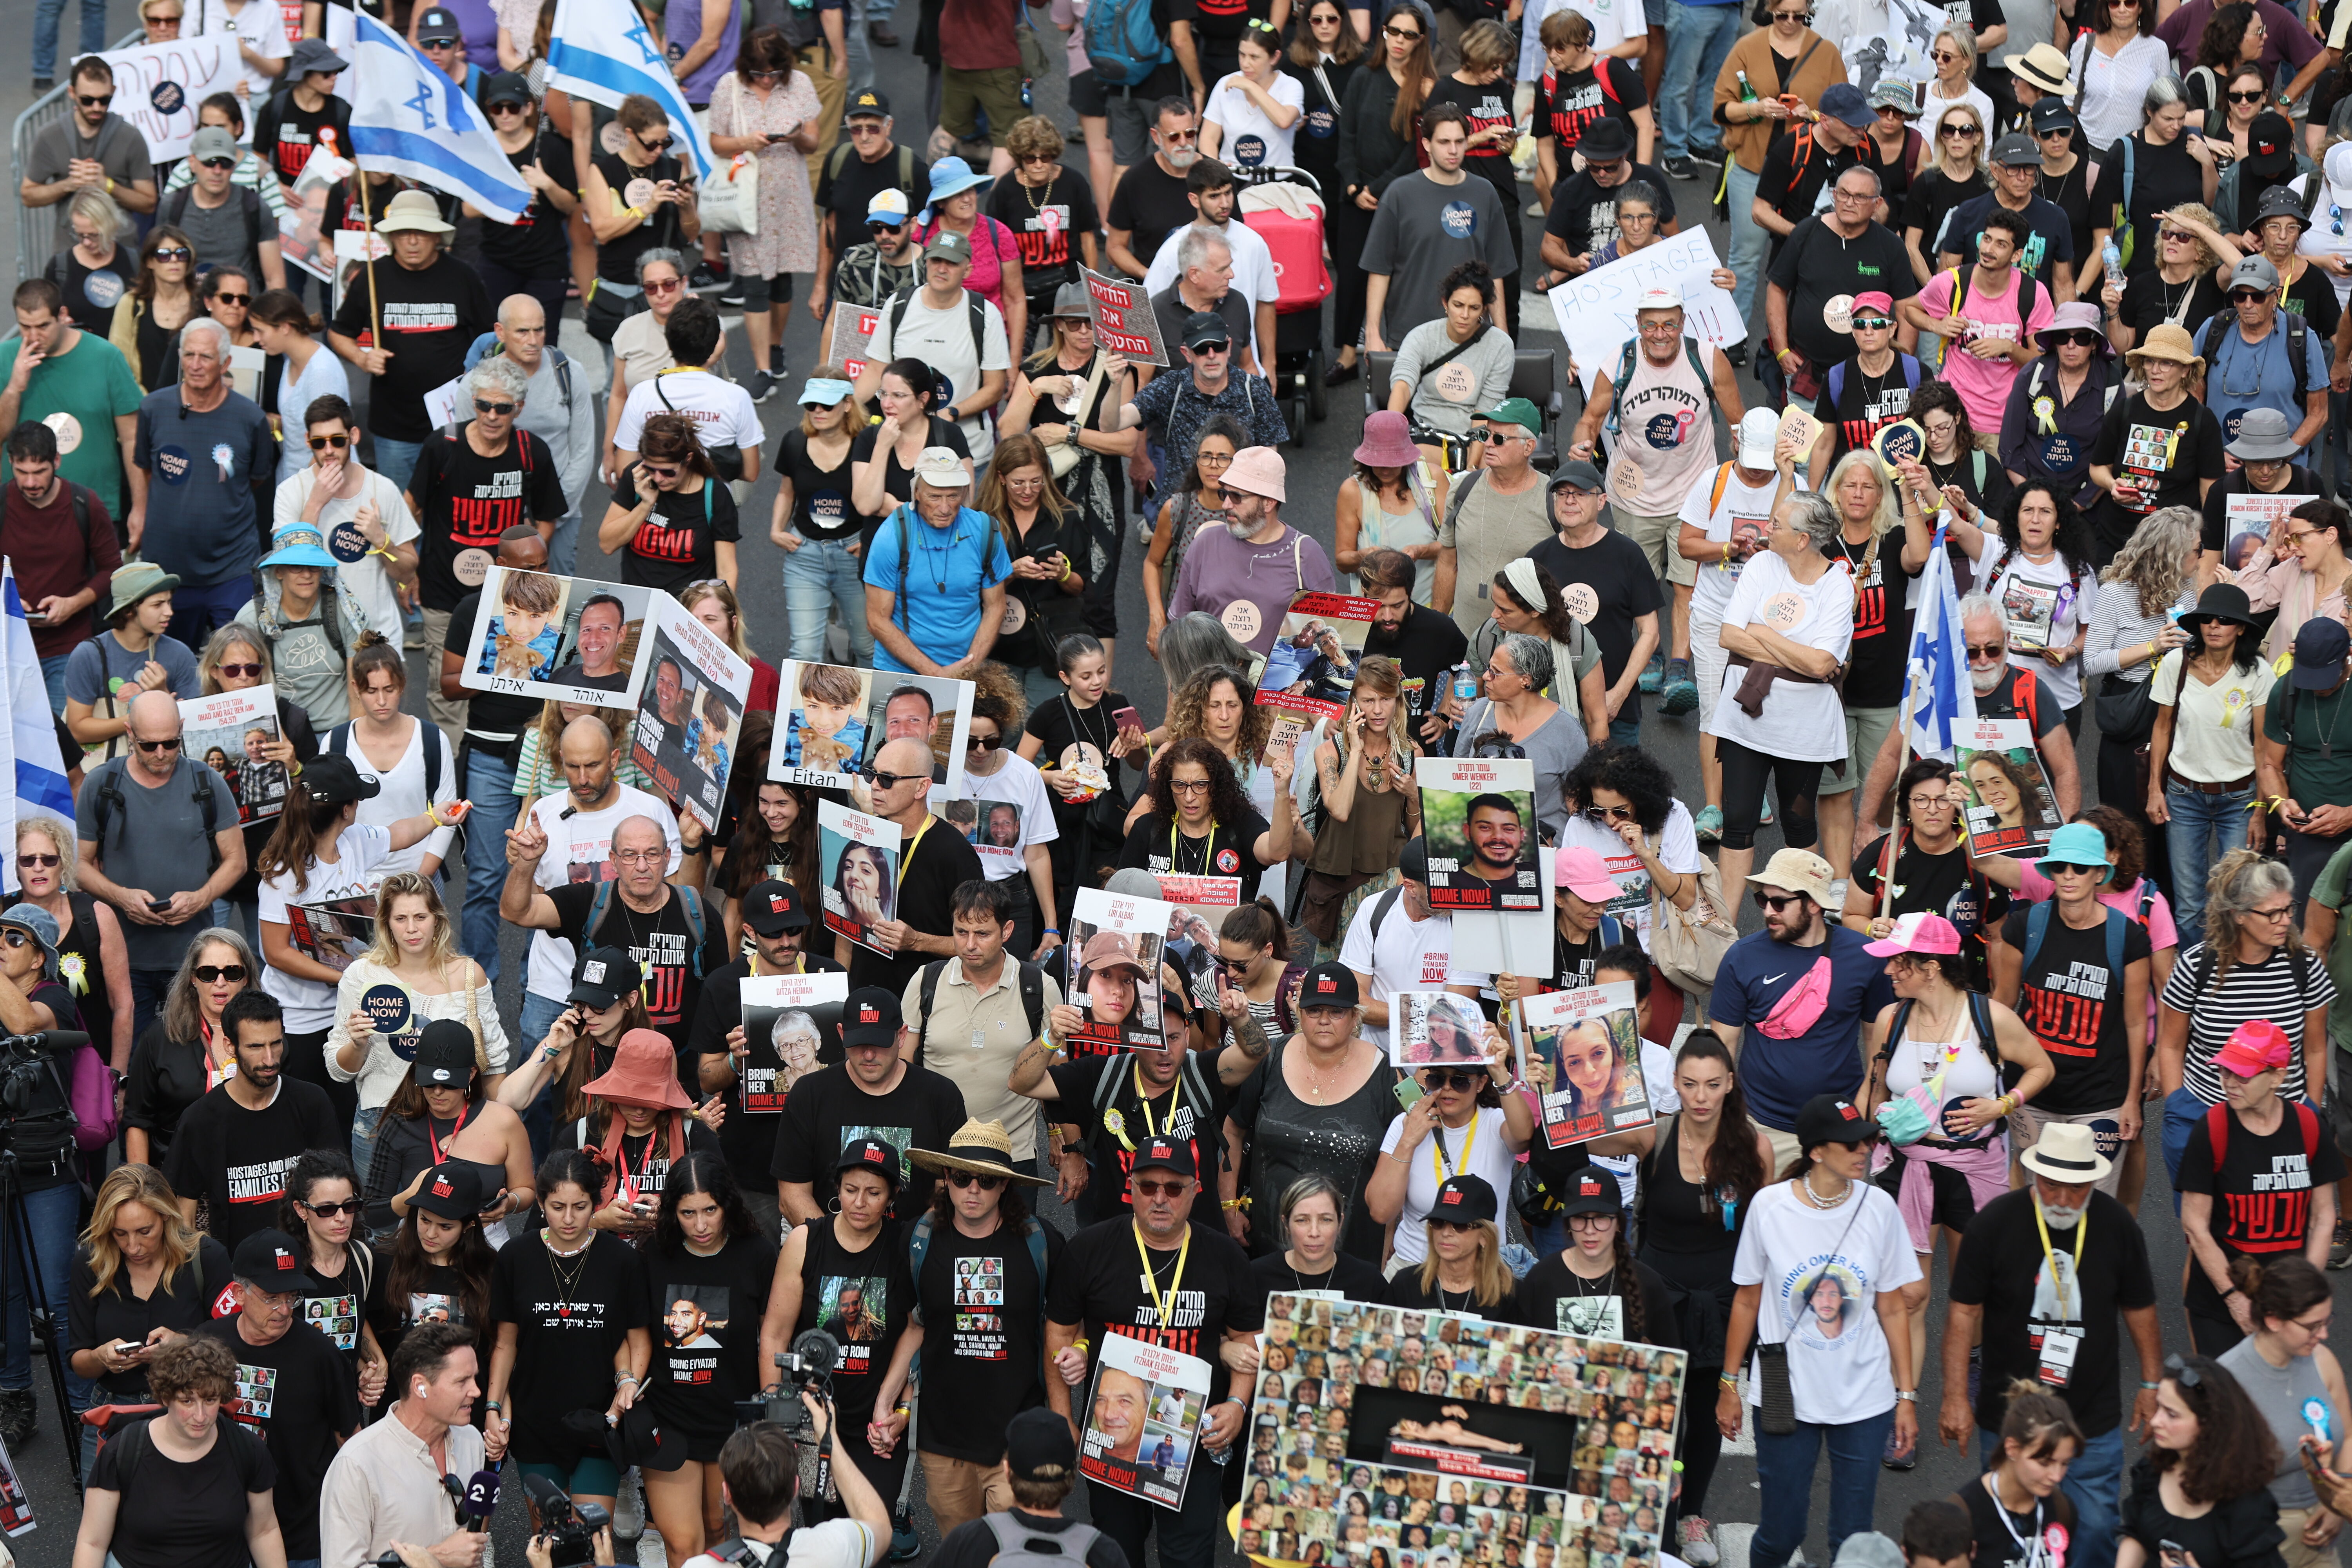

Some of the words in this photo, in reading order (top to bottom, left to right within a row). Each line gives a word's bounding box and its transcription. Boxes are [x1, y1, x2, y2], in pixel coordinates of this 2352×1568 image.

[1310, 118, 1332, 128] NOW
[1446, 210, 1472, 220] HOME
[1449, 218, 1471, 227] NOW
[1089, 279, 1128, 306] החזירו
[1101, 307, 1120, 326] את
[1096, 324, 1149, 352] החטופים
[1442, 383, 1466, 392] הביתה
[1624, 387, 1700, 416] דמוקרטיה
[1795, 418, 1806, 427] אני
[1788, 424, 1805, 436] רוצה
[1782, 429, 1804, 446] הביתה
[1885, 431, 1913, 451] HOME
[160, 452, 189, 468] HOME
[2046, 453, 2072, 462] הביתה
[161, 461, 184, 475] NOW
[1624, 465, 1633, 473] אני
[474, 485, 501, 499] הביתה
[817, 507, 841, 515] NOW
[651, 512, 670, 528] HOME
[336, 529, 366, 546] HOME
[335, 538, 363, 553] NOW
[1577, 590, 1587, 599] אני
[2018, 584, 2047, 598] KIDNAPPED
[1569, 596, 1588, 607] רוצה
[1777, 602, 1794, 615] רוצה
[1787, 598, 1797, 607] אני
[1338, 612, 1371, 620] KIDNAPPED
[675, 622, 687, 639] OHAD
[688, 633, 697, 648] AND
[698, 642, 710, 660] EITAN
[710, 653, 734, 681] YAHALOMI
[490, 677, 524, 691] איתן
[573, 688, 604, 703] אוהד
[198, 713, 212, 721] OHAD
[218, 716, 237, 726] (54,57)
[639, 707, 665, 741] BRING
[637, 724, 659, 756] THEM
[632, 742, 656, 772] HOME
[655, 762, 680, 796] NOW!
[793, 768, 837, 787] Eitan
[1469, 782, 1481, 791] (22)
[1966, 805, 1996, 822] BRING
[1971, 819, 1993, 834] HER
[1973, 831, 1998, 848] HOME
[2001, 826, 2026, 842] NOW!
[1428, 858, 1458, 872] BRING
[1429, 873, 1449, 886] HIM
[823, 884, 841, 903] BRING
[1430, 889, 1459, 902] HOME
[1461, 887, 1490, 903] NOW!
[771, 898, 790, 911] NOW
[304, 909, 318, 924] HIM
[317, 912, 333, 933] BRING
[1114, 919, 1123, 929] (18)
[650, 933, 686, 949] מחזירים
[2070, 961, 2109, 984] מחזירים
[1318, 981, 1337, 991] NOW
[2045, 973, 2080, 993] הביתה
[2078, 978, 2107, 1000] אותם
[793, 987, 813, 995] HEIMAN
[368, 997, 403, 1007] HOME
[790, 996, 800, 1004] (84)
[1069, 992, 1092, 1008] BRING
[1553, 1005, 1573, 1014] MORAN
[1574, 1000, 1590, 1009] STELA
[1592, 996, 1608, 1005] YANAI
[370, 1008, 401, 1017] NOW
[860, 1011, 879, 1020] NOW
[1576, 1009, 1586, 1018] (40)
[748, 1068, 776, 1080] BRING
[748, 1081, 766, 1093] HER
[749, 1094, 774, 1105] HOME
[1544, 1091, 1572, 1109] BRING
[1546, 1106, 1565, 1124] HER
[1549, 1121, 1575, 1140] HOME
[1577, 1112, 1605, 1133] NOW!
[864, 1149, 885, 1161] NOW
[1152, 1147, 1172, 1157] NOW
[227, 1163, 267, 1180] HOSTAGES
[268, 1160, 284, 1174] AND
[229, 1174, 279, 1198] FAMILIES
[432, 1181, 454, 1196] NOW
[2253, 1173, 2286, 1191] הביתה
[277, 1255, 294, 1267] NOW
[532, 1302, 550, 1314] כאן.
[554, 1299, 566, 1311] לא
[569, 1303, 589, 1311] שאת
[593, 1304, 604, 1314] עד
[543, 1318, 560, 1327] שם.
[563, 1318, 584, 1329] איתך
[587, 1317, 604, 1328] הלב
[850, 1345, 870, 1358] ROMI
[670, 1358, 689, 1370] BRING
[690, 1357, 717, 1369] EVYATAR
[1134, 1356, 1153, 1368] ITZHAK
[1154, 1361, 1179, 1375] ELGARAT
[673, 1371, 692, 1381] HOME
[693, 1370, 711, 1381] NOW!
[1148, 1369, 1160, 1380] (68)
[1086, 1428, 1115, 1449] BRING
[1083, 1445, 1102, 1460] HIM
[1394, 1444, 1427, 1457] Please
[1429, 1450, 1450, 1462] help
[1452, 1452, 1479, 1464] bring
[1082, 1455, 1108, 1475] HOME
[1108, 1466, 1136, 1487] NOW!
[1440, 1461, 1460, 1470] them
[1462, 1463, 1491, 1474] home
[1493, 1468, 1521, 1480] alive.
[470, 1483, 485, 1502] 2
[492, 1487, 500, 1504] 2
